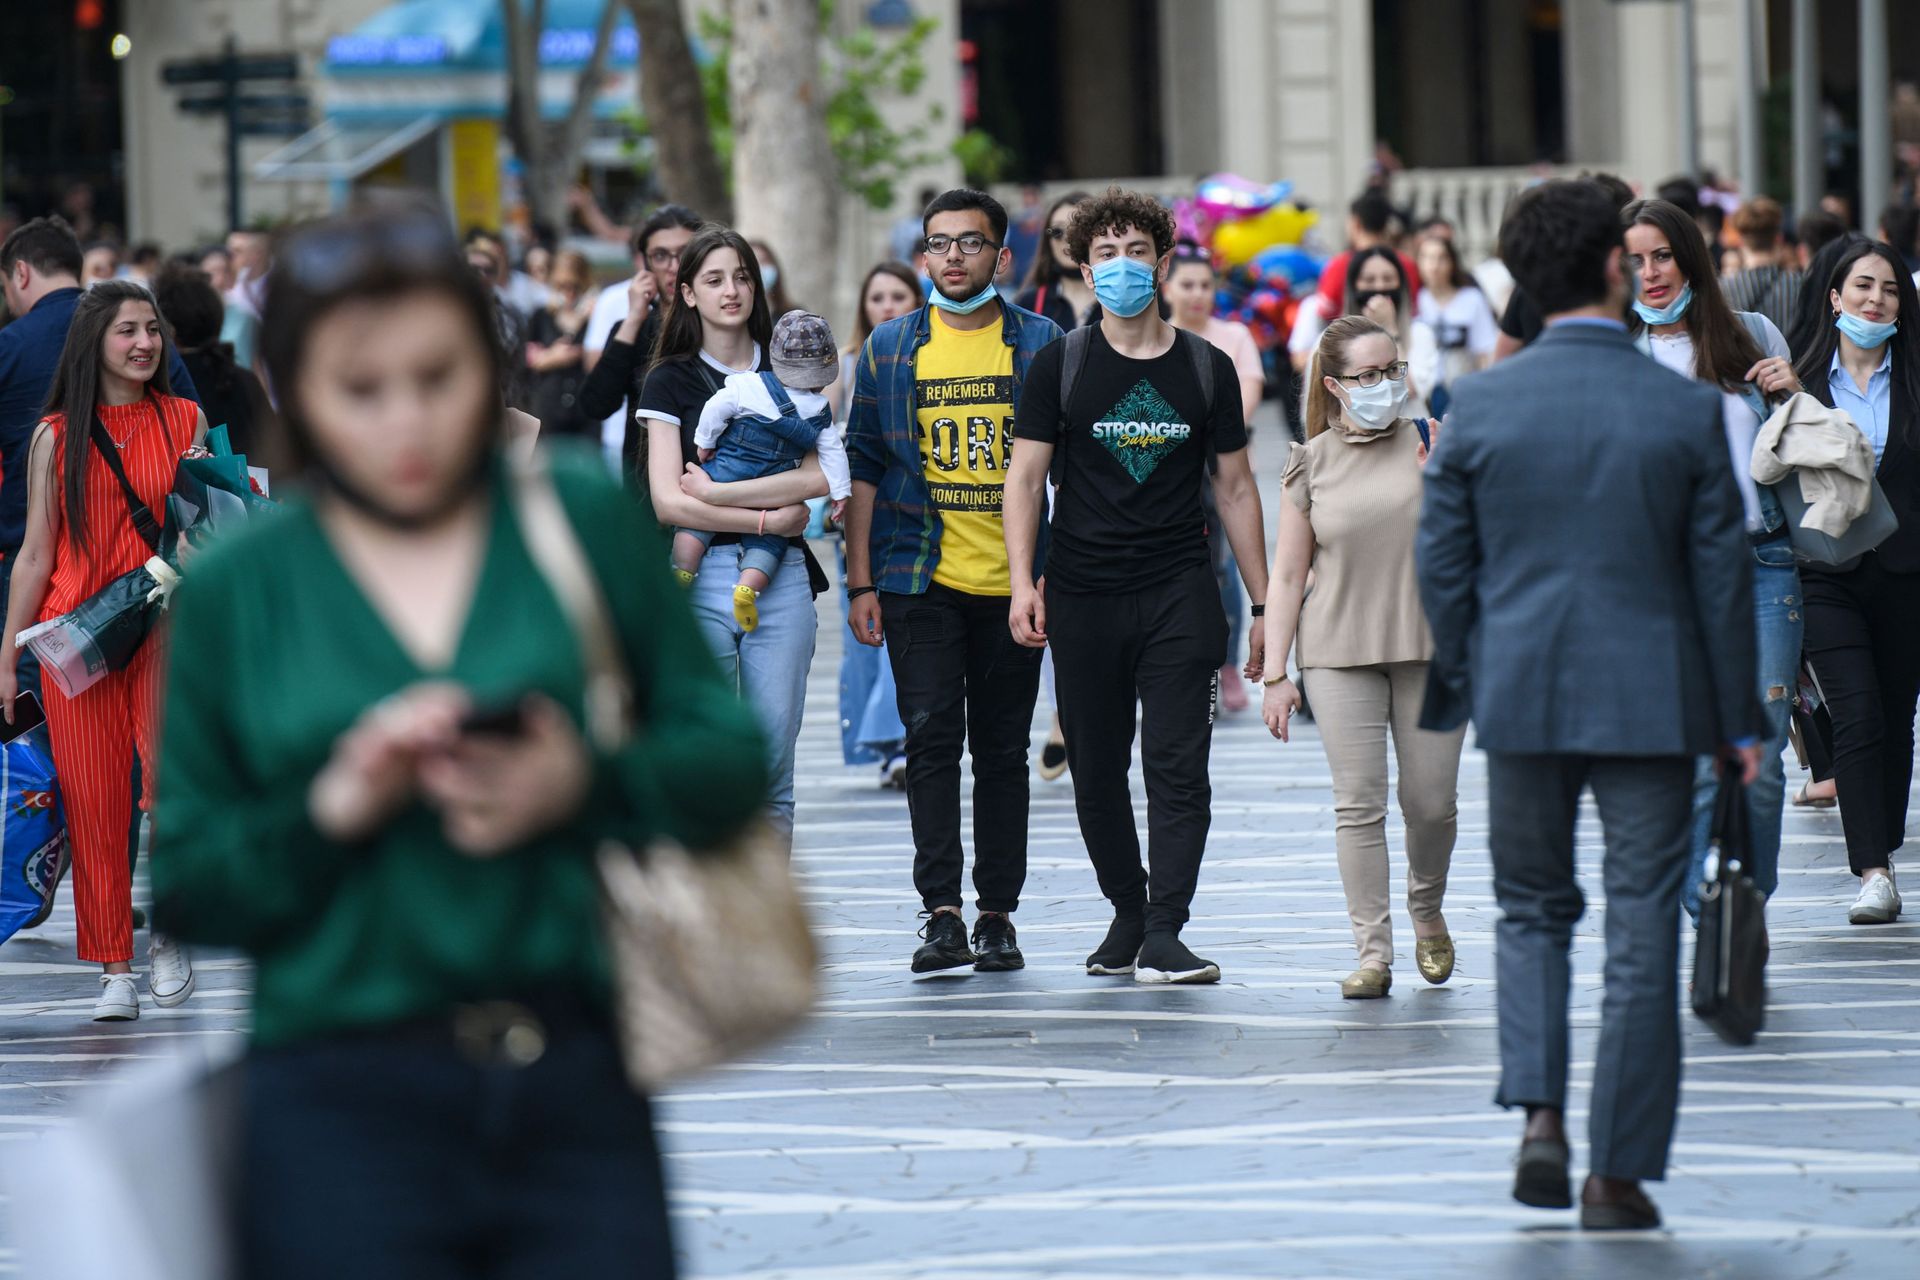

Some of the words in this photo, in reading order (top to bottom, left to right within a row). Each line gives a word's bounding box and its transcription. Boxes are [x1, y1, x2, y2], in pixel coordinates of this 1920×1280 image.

[926, 382, 996, 401] REMEMBER
[1092, 421, 1191, 439] STRONGER
[917, 415, 1015, 471] OR
